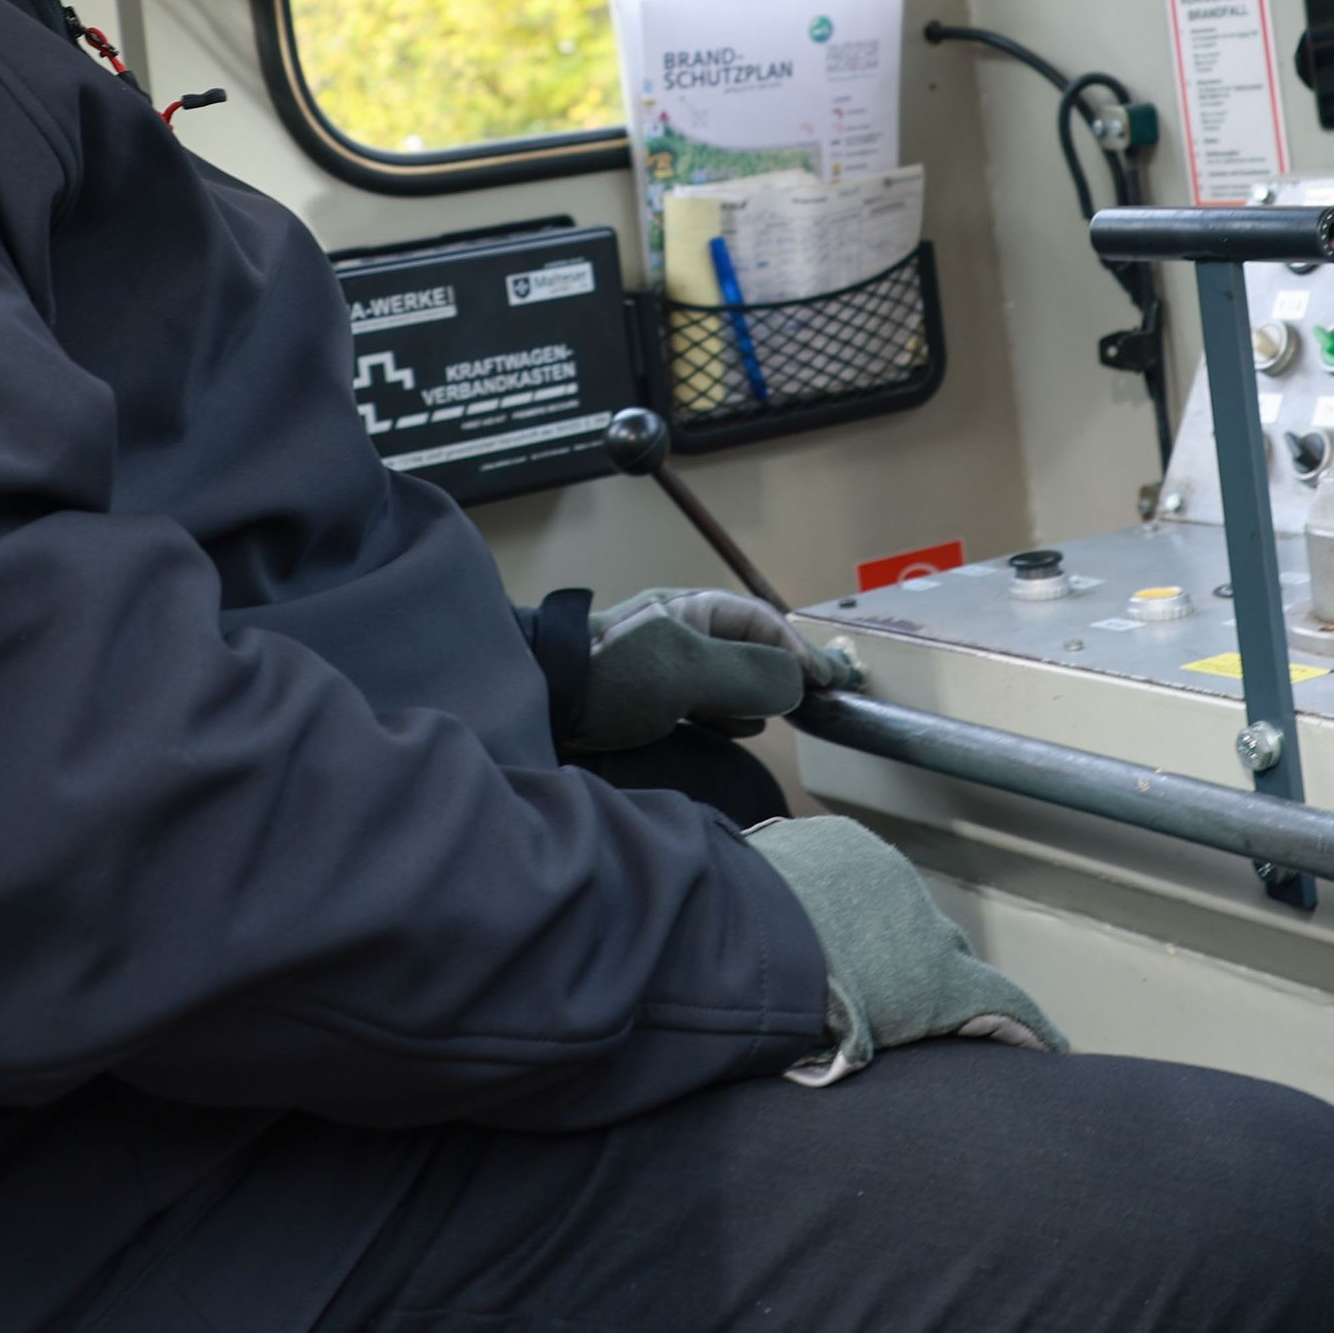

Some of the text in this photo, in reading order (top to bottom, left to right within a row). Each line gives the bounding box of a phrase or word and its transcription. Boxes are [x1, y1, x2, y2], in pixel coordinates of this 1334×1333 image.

[663, 46, 744, 70] BRAND-
[663, 61, 794, 91] SCHUTZPLAN
[445, 344, 574, 382] KRAFTWAGEN-
[421, 362, 576, 406] VERBANDKASTEN
